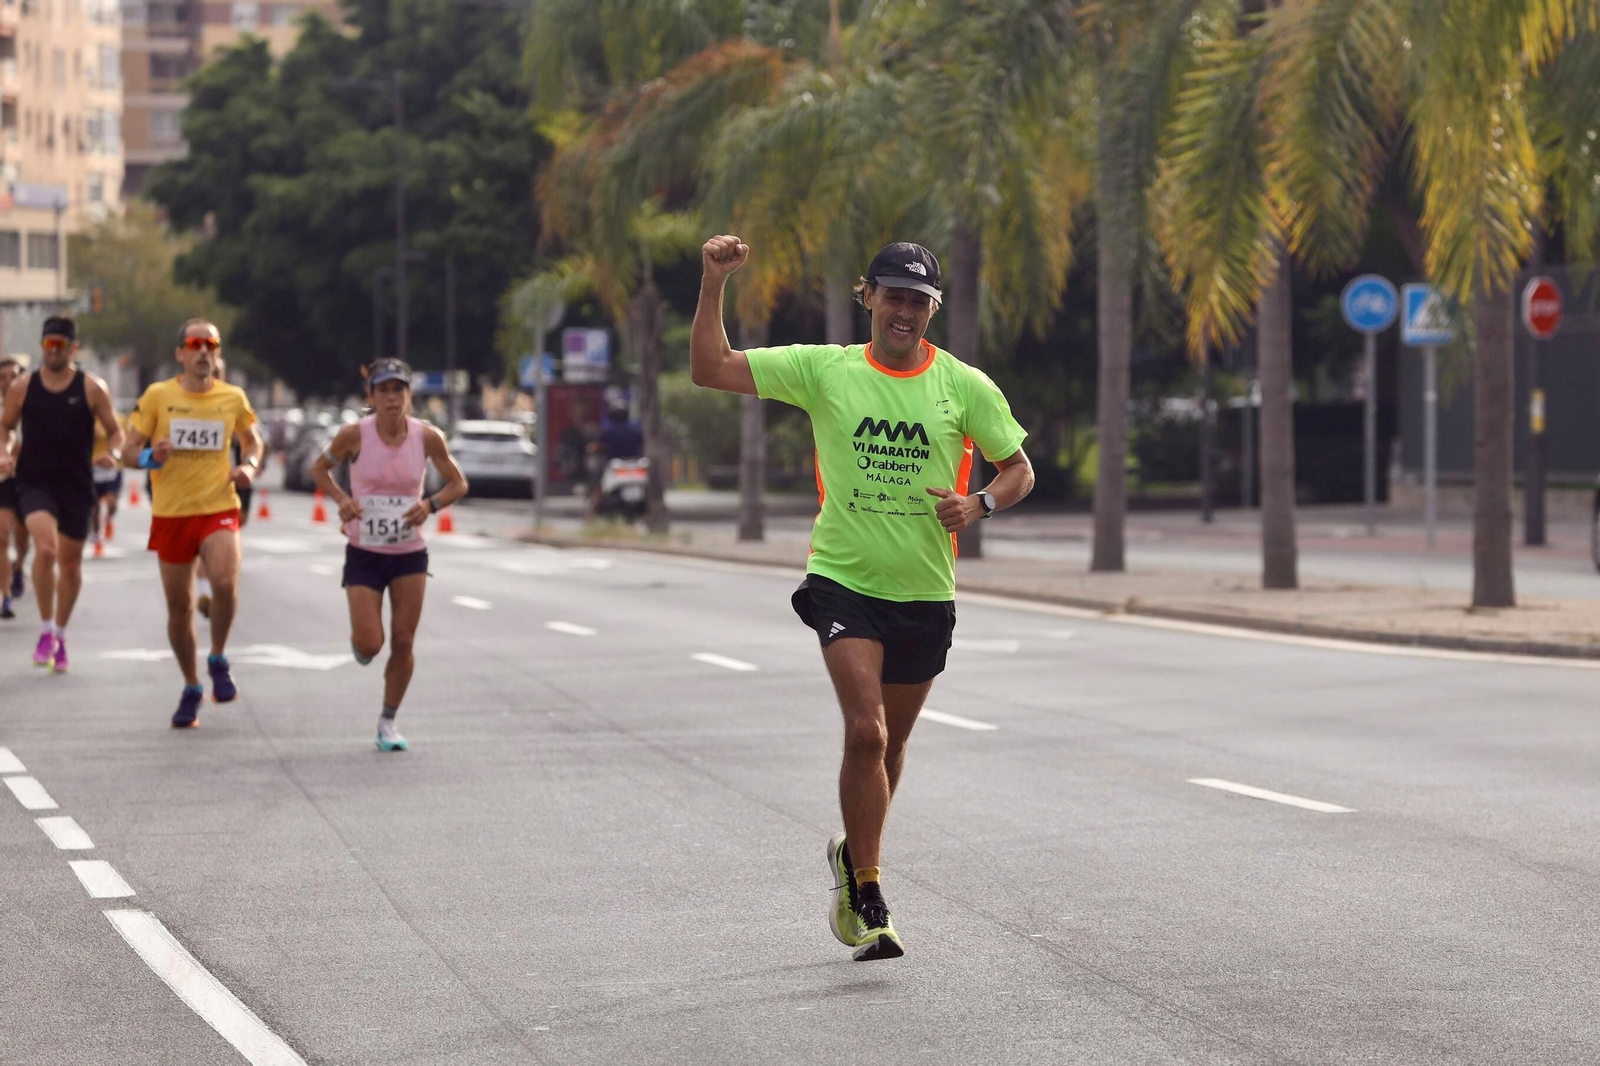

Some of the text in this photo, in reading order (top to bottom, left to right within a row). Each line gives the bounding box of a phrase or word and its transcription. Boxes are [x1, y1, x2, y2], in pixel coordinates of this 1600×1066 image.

[175, 429, 219, 446] 7451
[852, 441, 930, 460] VI MARATÓN
[872, 459, 923, 475] cabberty
[866, 472, 912, 486] MÁLAGA
[365, 519, 408, 536] 151
